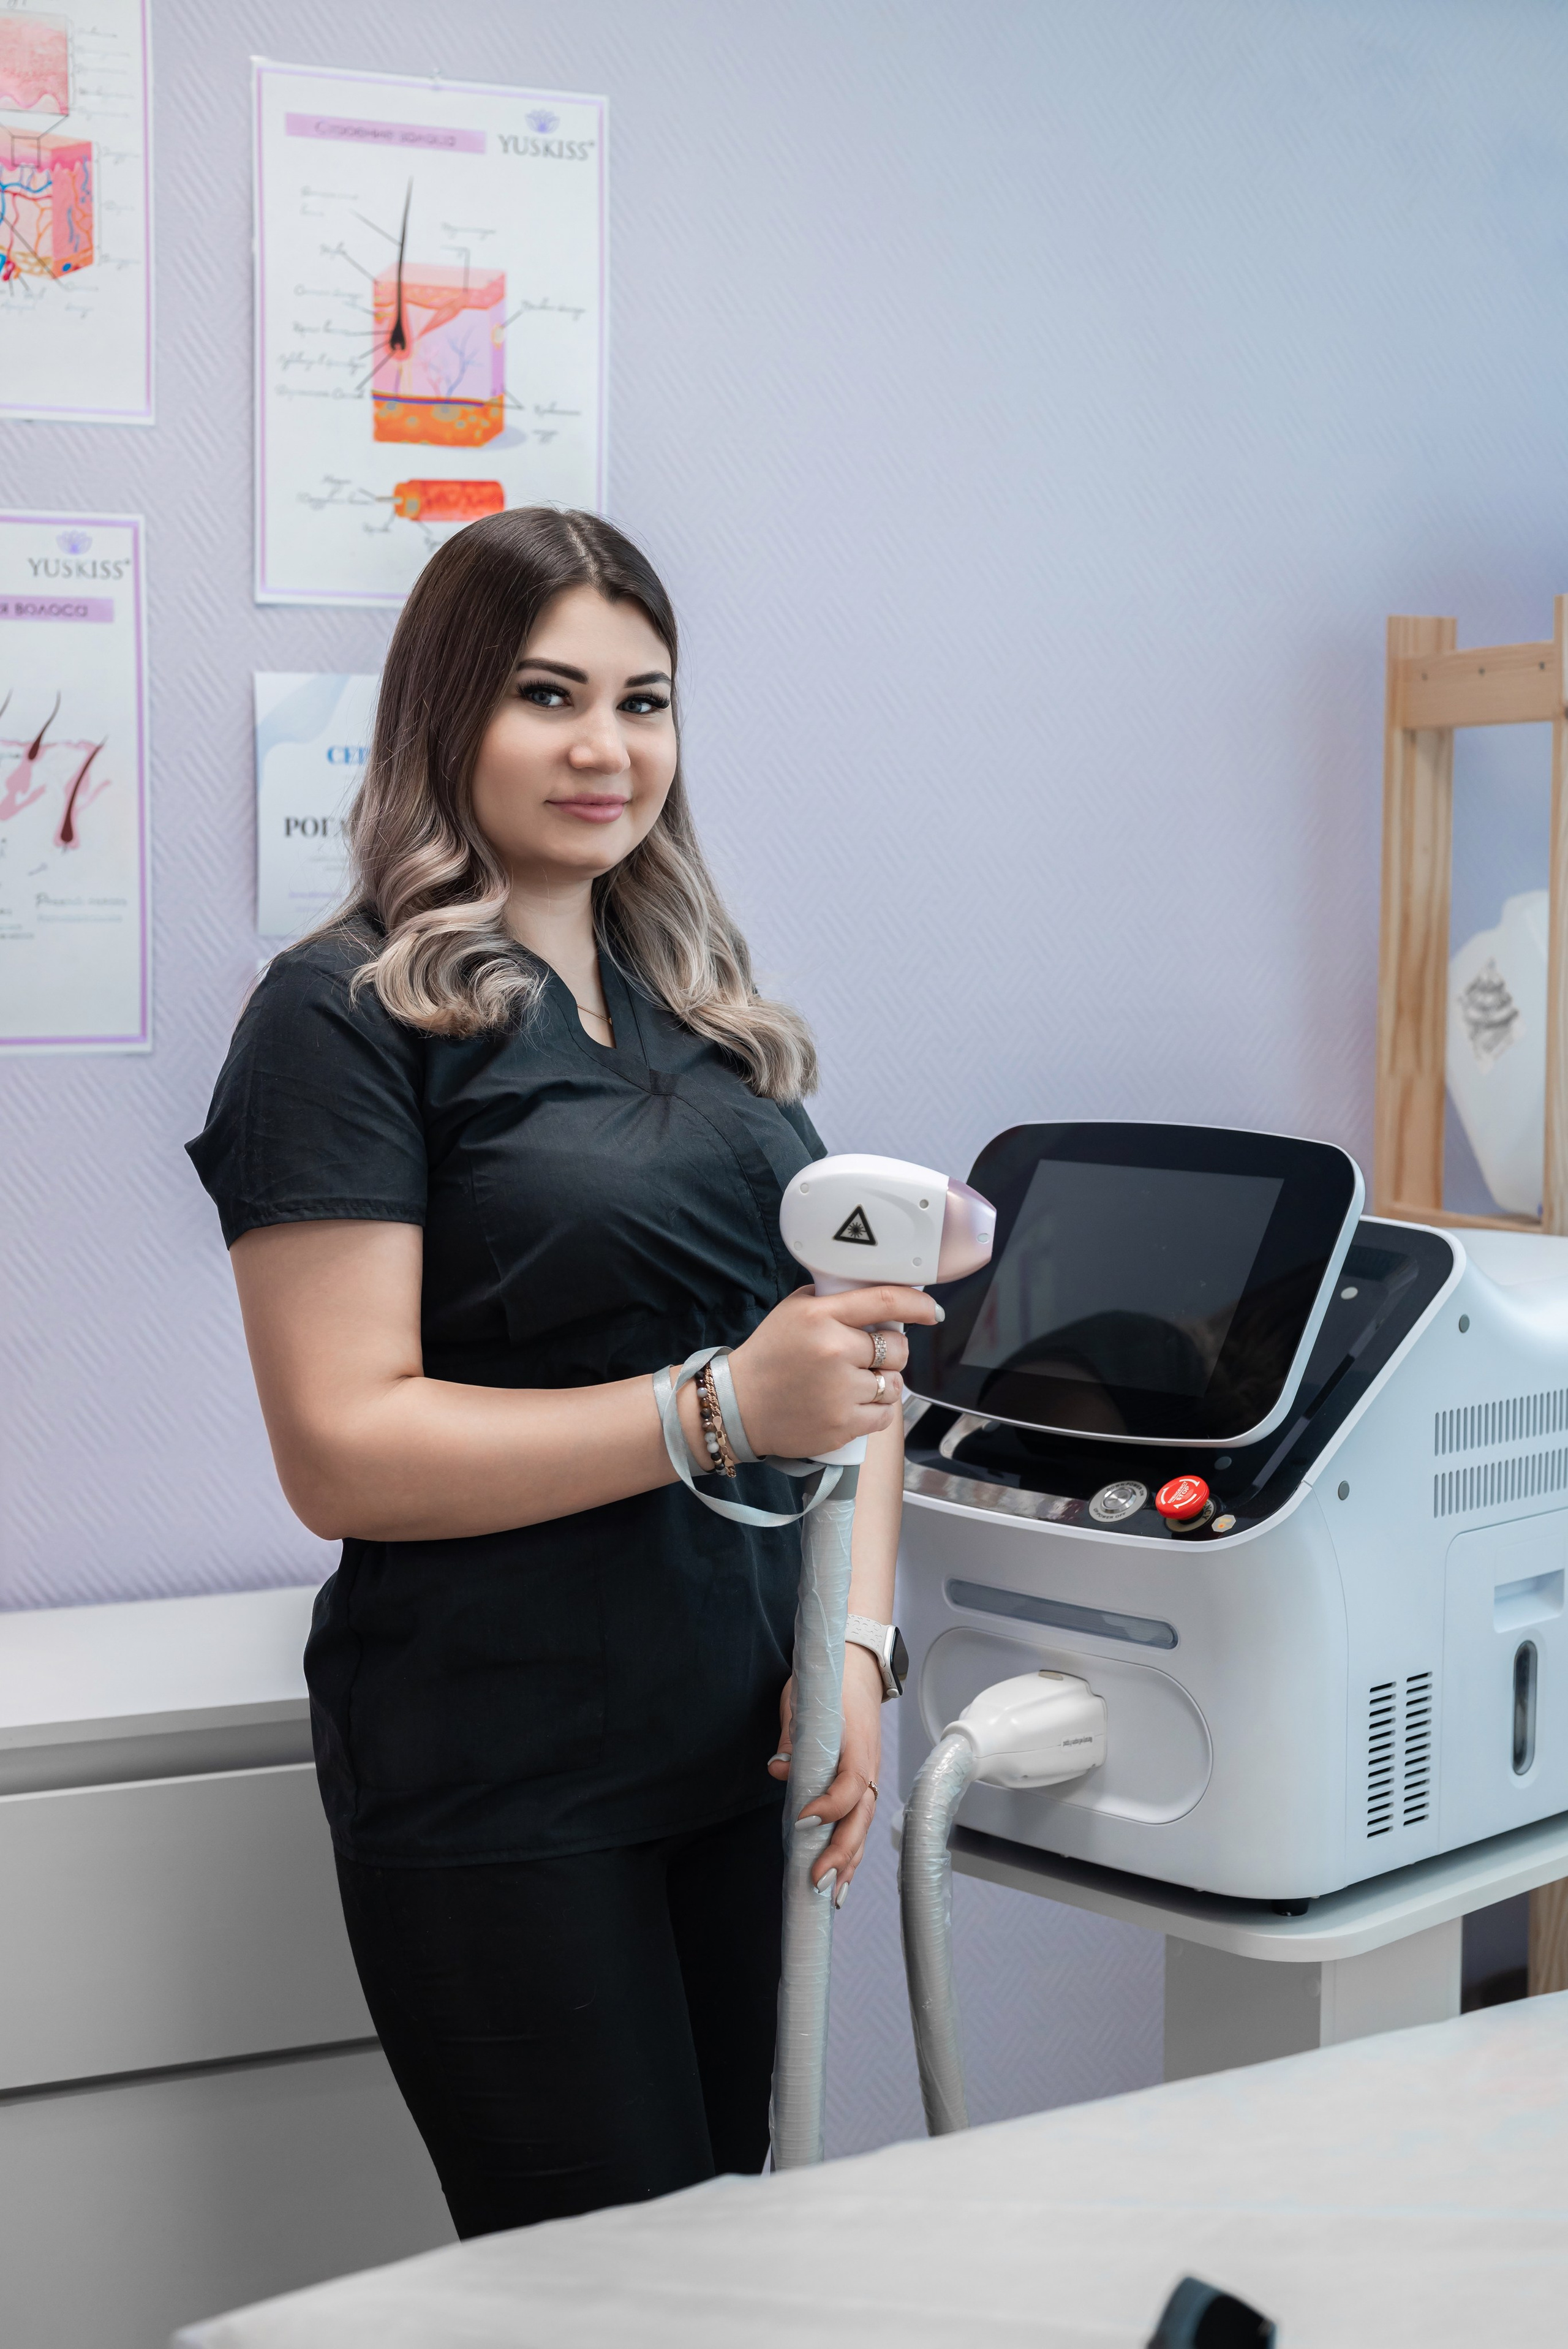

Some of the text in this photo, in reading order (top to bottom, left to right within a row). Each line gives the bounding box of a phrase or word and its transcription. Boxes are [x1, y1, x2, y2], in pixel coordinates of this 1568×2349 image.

[497, 134, 590, 162] YUSKISS
[28, 557, 124, 580] YUSKISS
[1176, 1485, 1189, 1501] STOP
